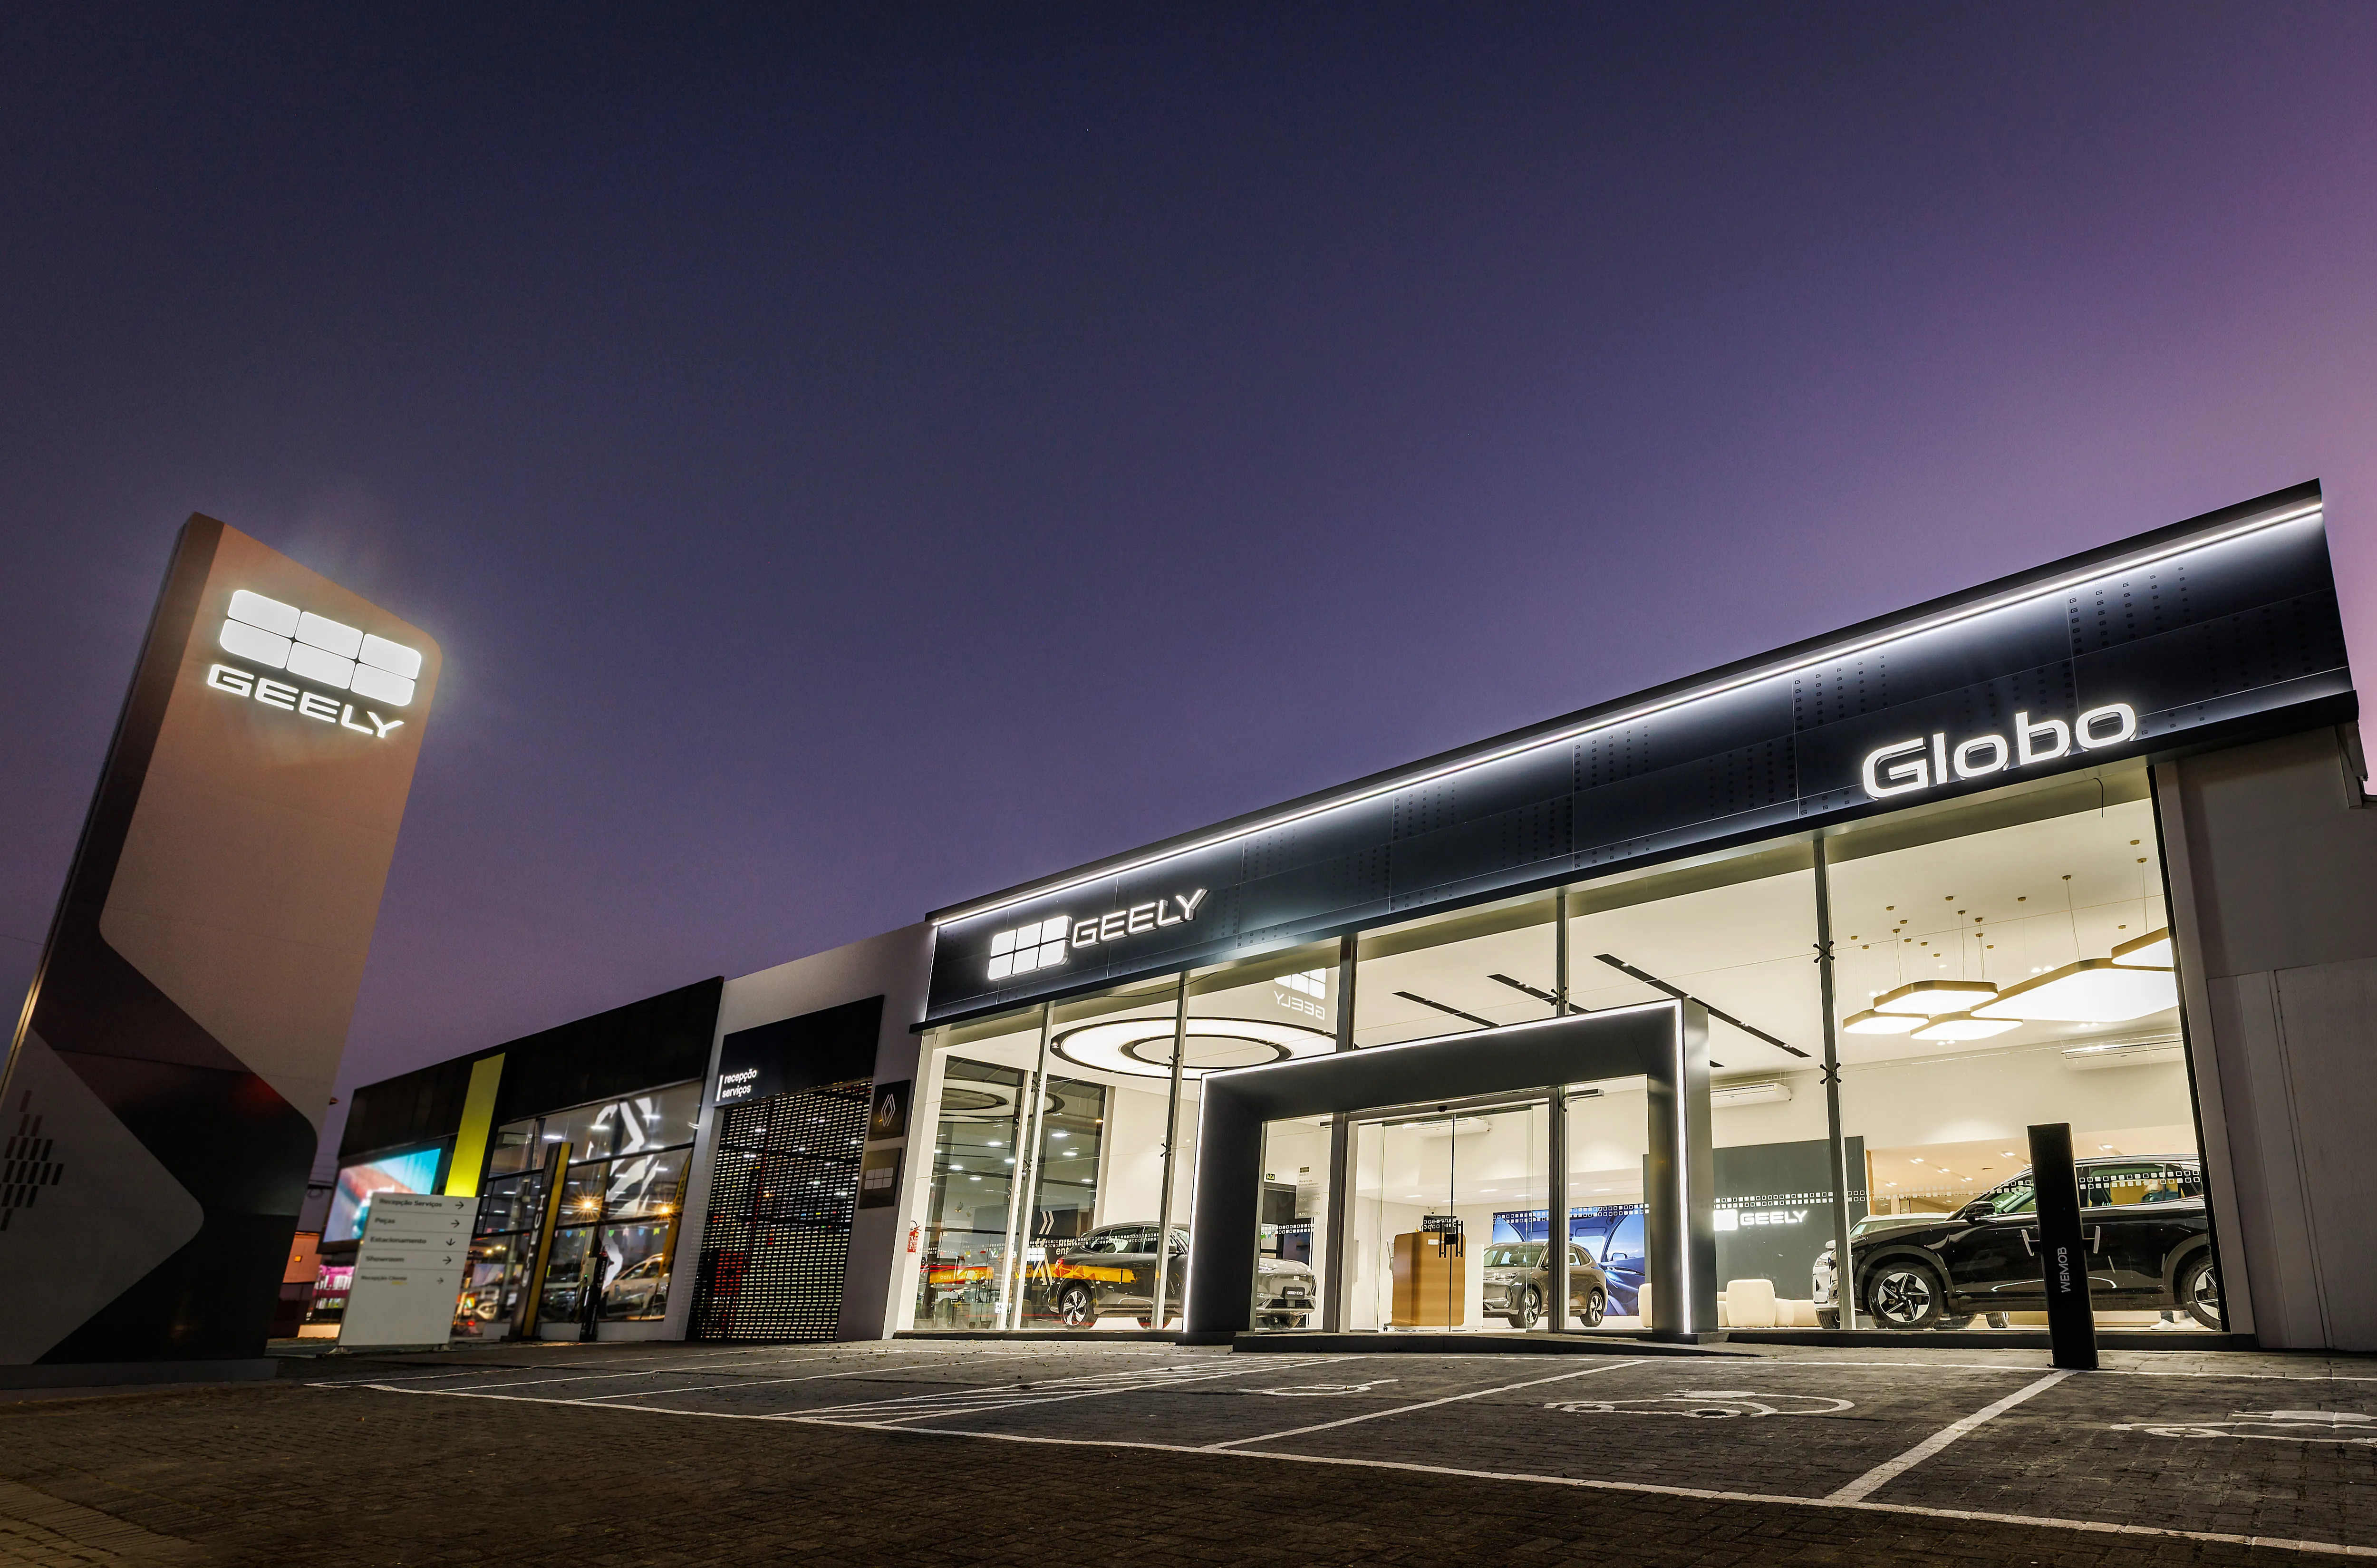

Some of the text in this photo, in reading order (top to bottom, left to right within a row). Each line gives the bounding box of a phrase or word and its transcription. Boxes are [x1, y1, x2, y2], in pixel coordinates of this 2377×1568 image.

[207, 663, 405, 738] GEELY
[1862, 703, 2137, 800] Globo
[1072, 888, 1209, 949] GEELY
[722, 1085, 752, 1098] serviços
[724, 1068, 757, 1084] recepção
[522, 1194, 546, 1287] E-TECH
[1739, 1210, 1808, 1225] GEELY
[2060, 1247, 2070, 1293] WEMOB
